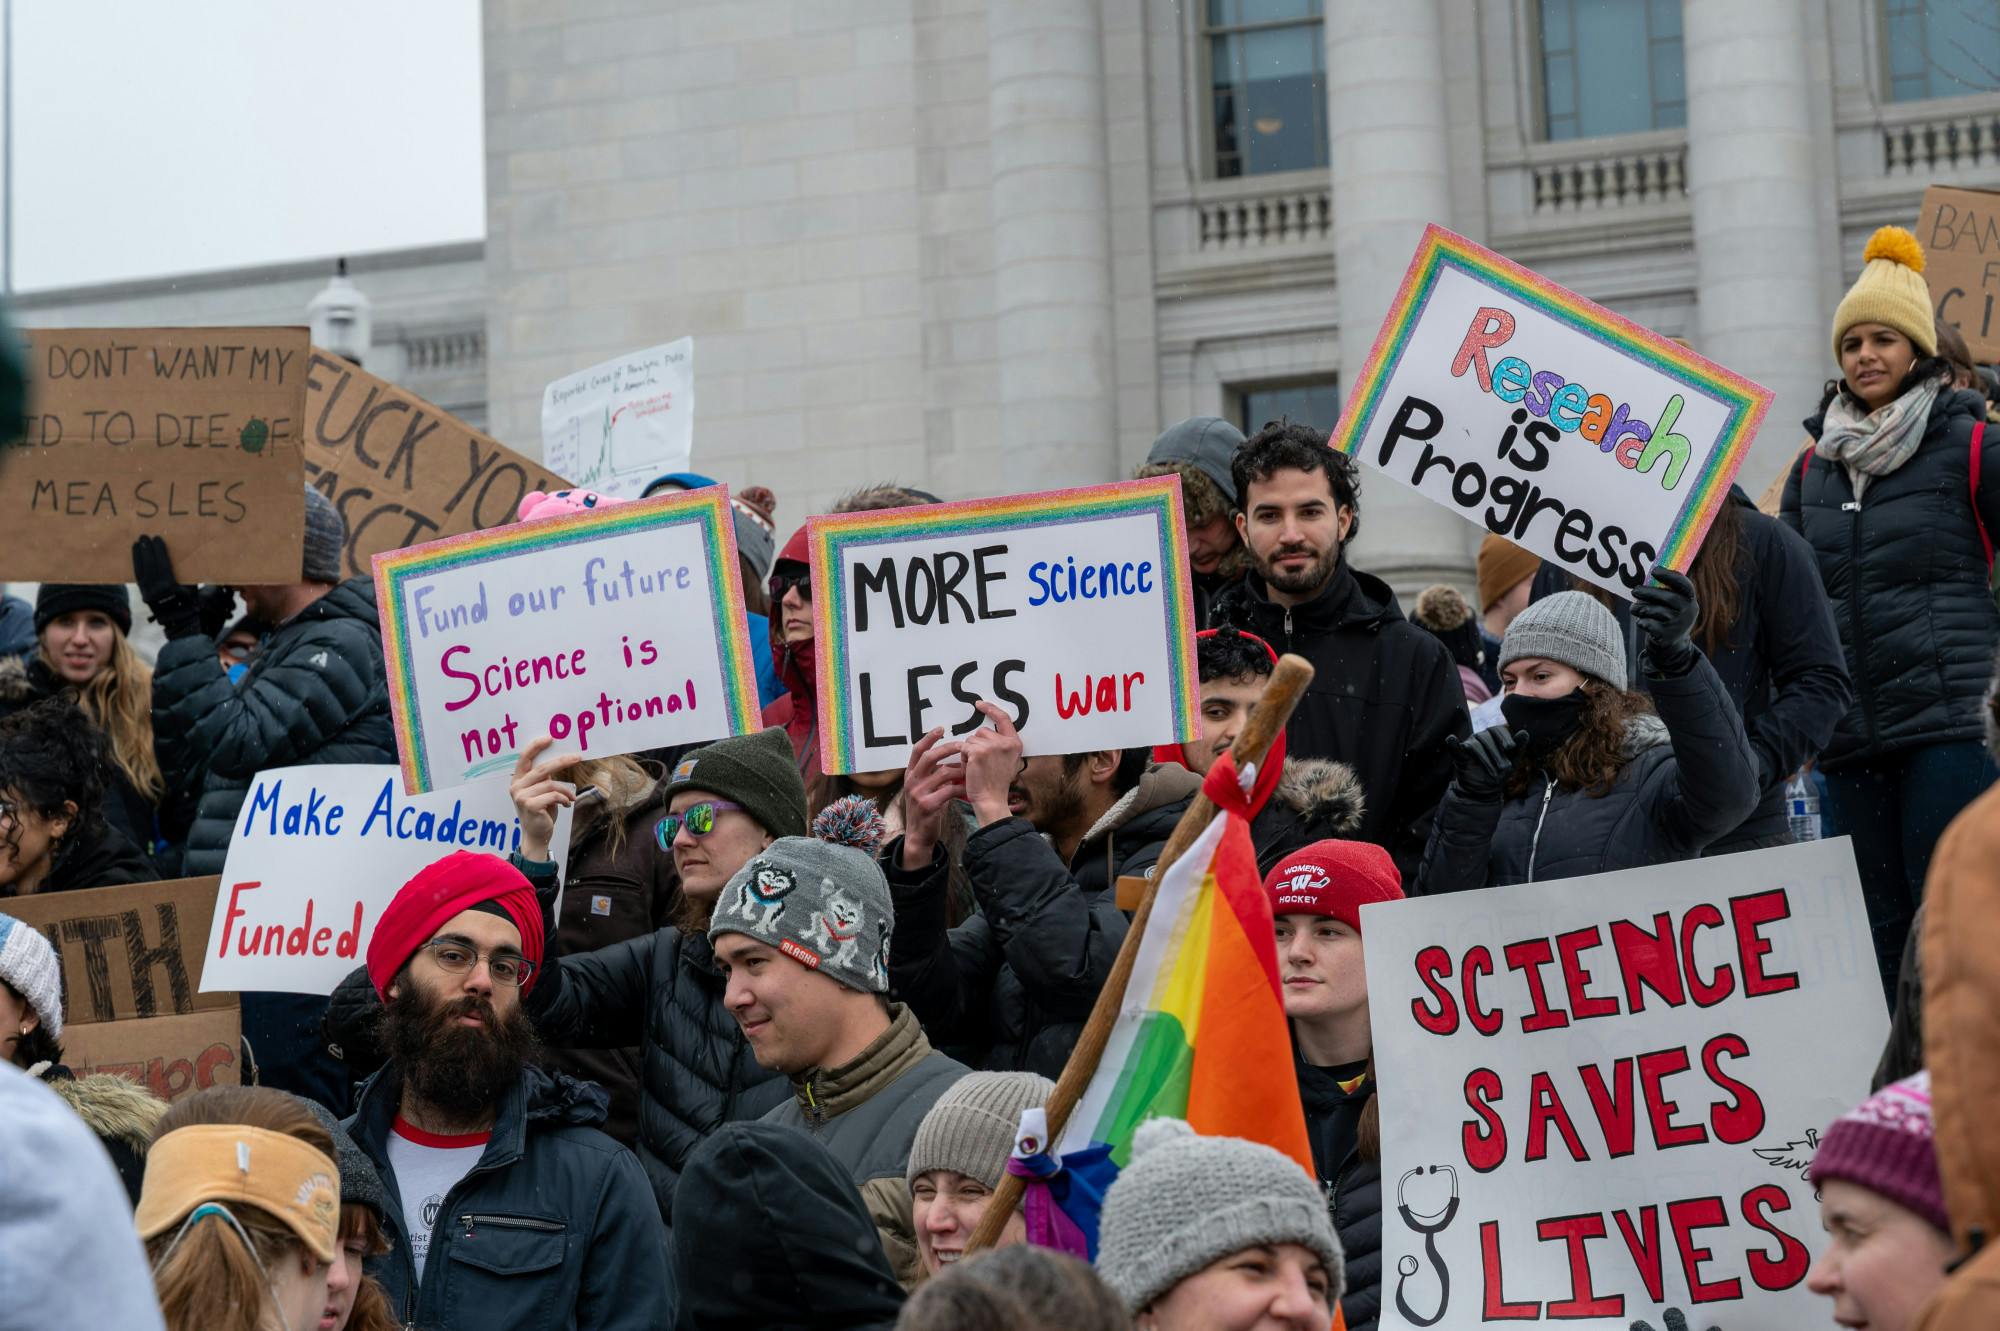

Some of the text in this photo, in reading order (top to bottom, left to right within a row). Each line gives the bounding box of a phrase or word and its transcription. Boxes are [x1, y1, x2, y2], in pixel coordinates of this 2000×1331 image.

[48, 340, 138, 380] DON'T
[154, 345, 246, 380] WANT
[249, 347, 294, 384] MY
[1450, 306, 1692, 491] Research
[16, 413, 63, 448] ID
[83, 410, 135, 446] TO
[156, 412, 230, 449] DIE
[306, 353, 441, 491] FUCK
[444, 438, 548, 533] YO
[1497, 408, 1560, 472] is
[31, 479, 247, 524] MEASLES
[1378, 395, 1656, 590] Progress
[414, 557, 691, 638] Fund our future
[853, 544, 1153, 632] MORE science
[440, 636, 658, 712] Science is
[859, 659, 1144, 748] LESS war
[460, 679, 697, 763] not optional
[243, 778, 344, 837] Make
[1279, 895, 1318, 905] HOCKEY
[1284, 864, 1326, 876] WOMEN'S
[219, 881, 363, 960] Funded
[781, 941, 817, 967] ALASKA
[1411, 888, 1799, 1036] SCIENCE
[1461, 1033, 1766, 1173] SAVES
[1479, 1183, 1811, 1322] LIVES
